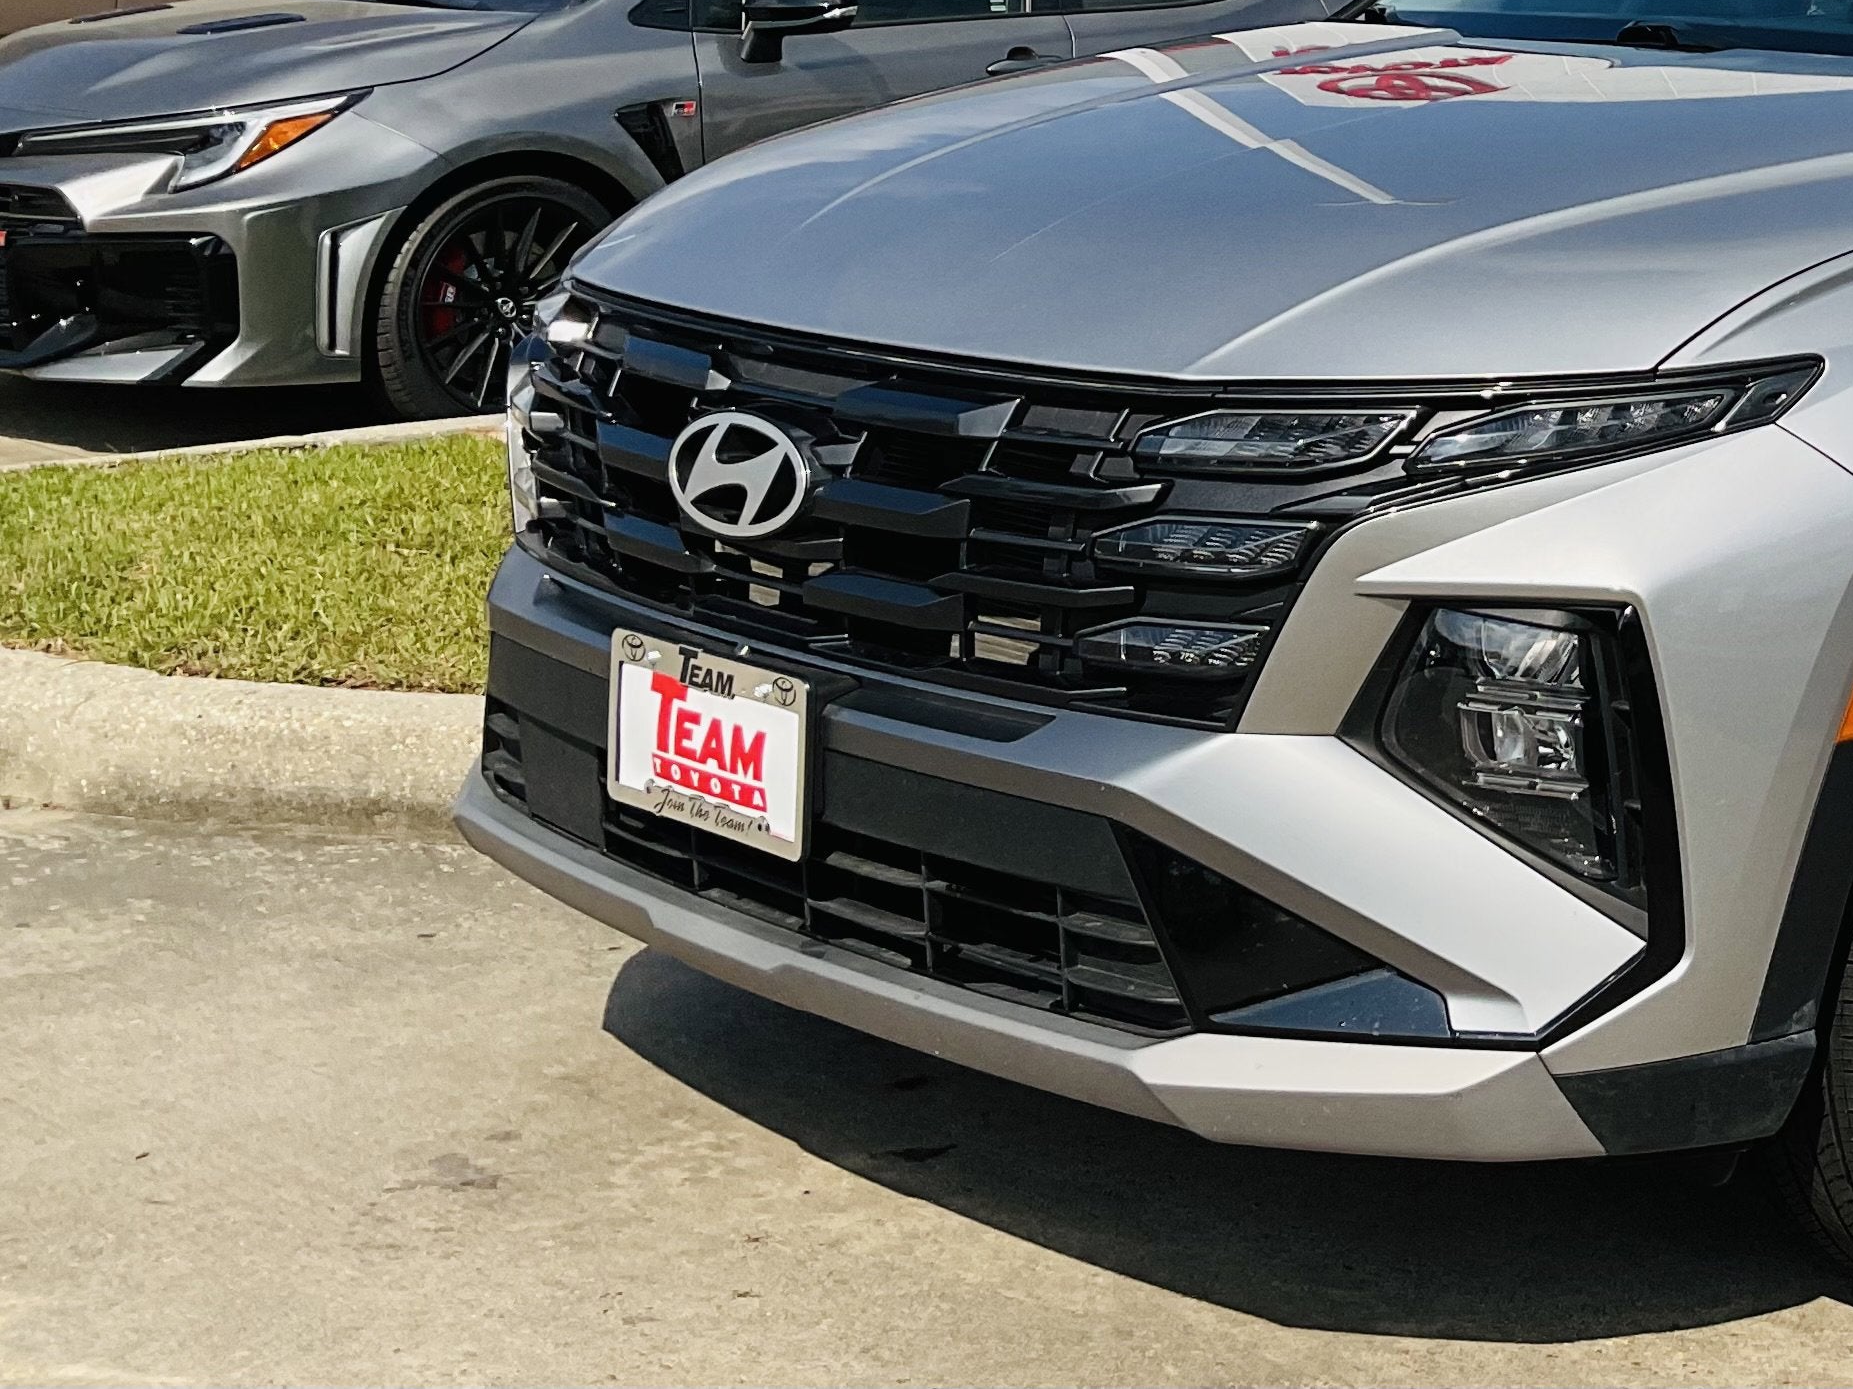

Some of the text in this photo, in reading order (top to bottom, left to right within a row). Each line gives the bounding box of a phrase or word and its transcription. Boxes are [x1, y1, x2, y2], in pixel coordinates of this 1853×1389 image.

[651, 671, 767, 782] TEAM
[653, 757, 765, 807] TOYOTA
[654, 788, 685, 814] Join
[688, 796, 711, 822] The
